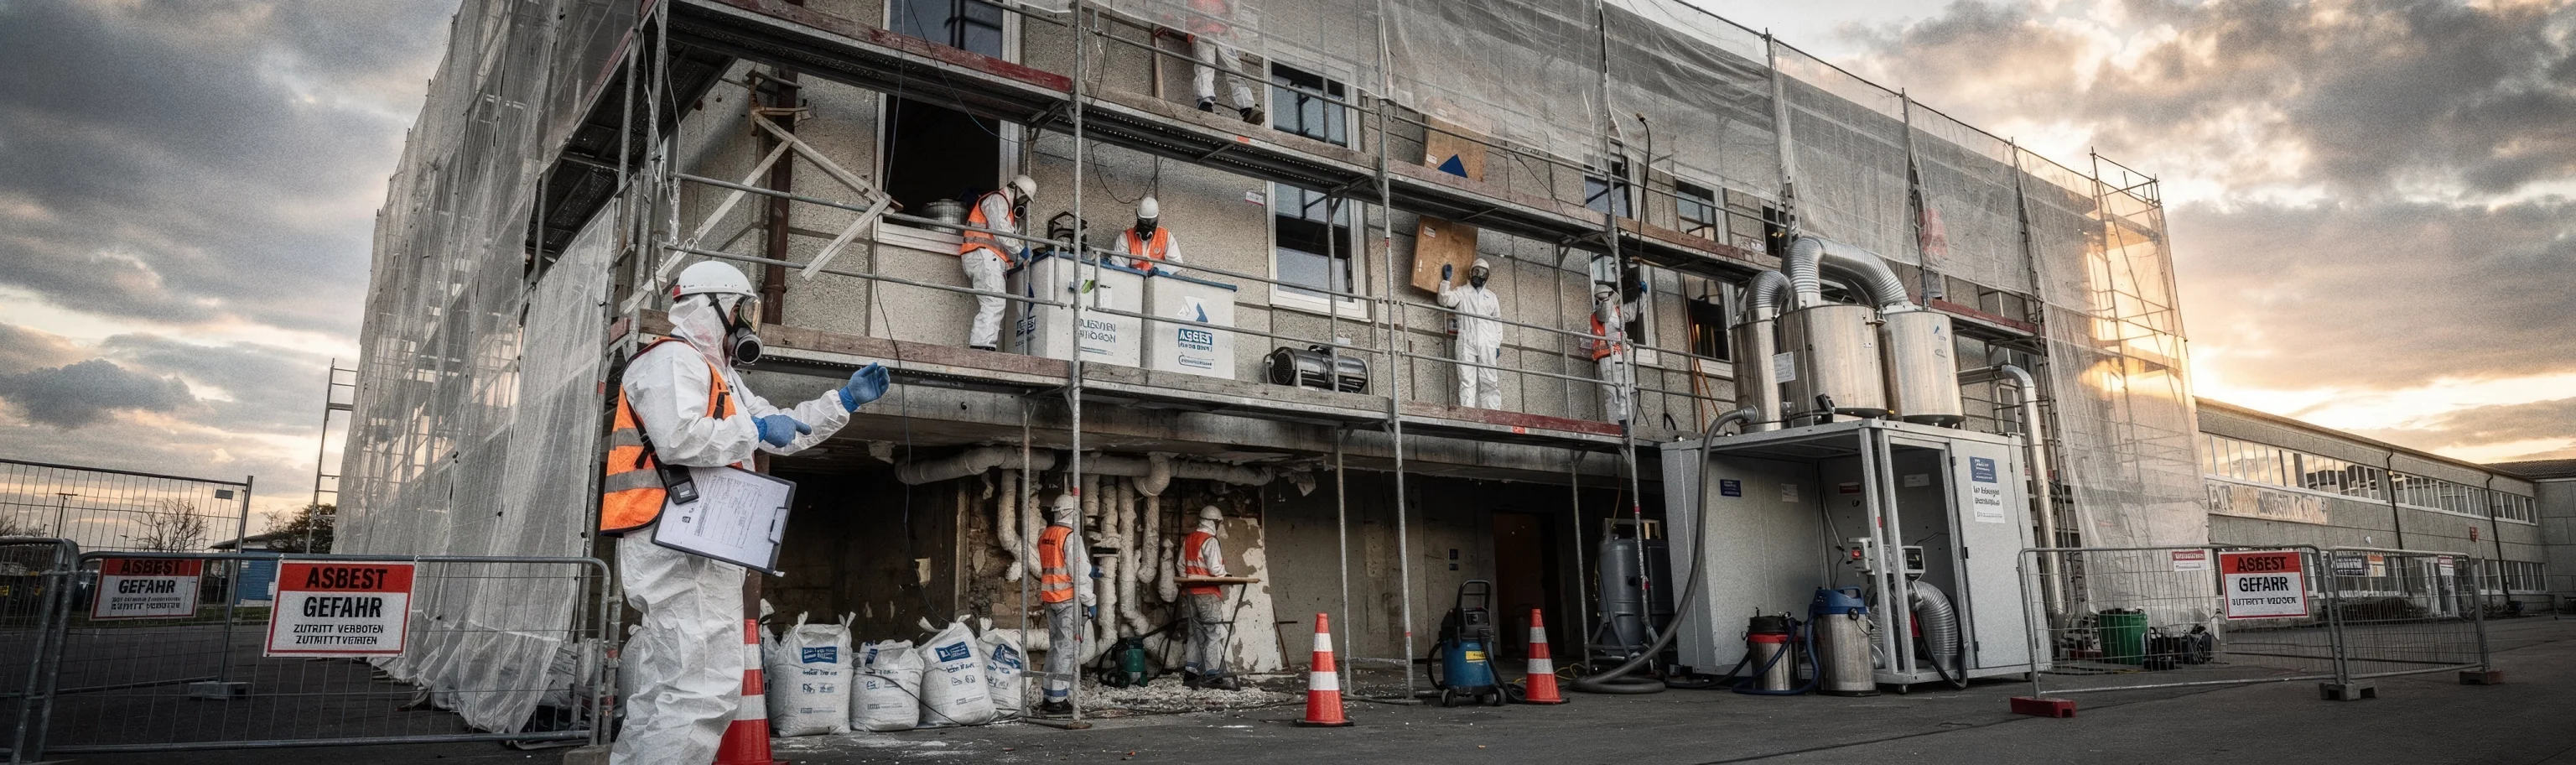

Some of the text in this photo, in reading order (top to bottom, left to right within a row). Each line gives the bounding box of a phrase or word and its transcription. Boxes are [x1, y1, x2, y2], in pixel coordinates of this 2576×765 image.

[120, 559, 184, 575] ASBEST
[118, 579, 176, 594] GEFAHR
[305, 566, 387, 590] ASBEST
[303, 596, 383, 618] GEFAHR
